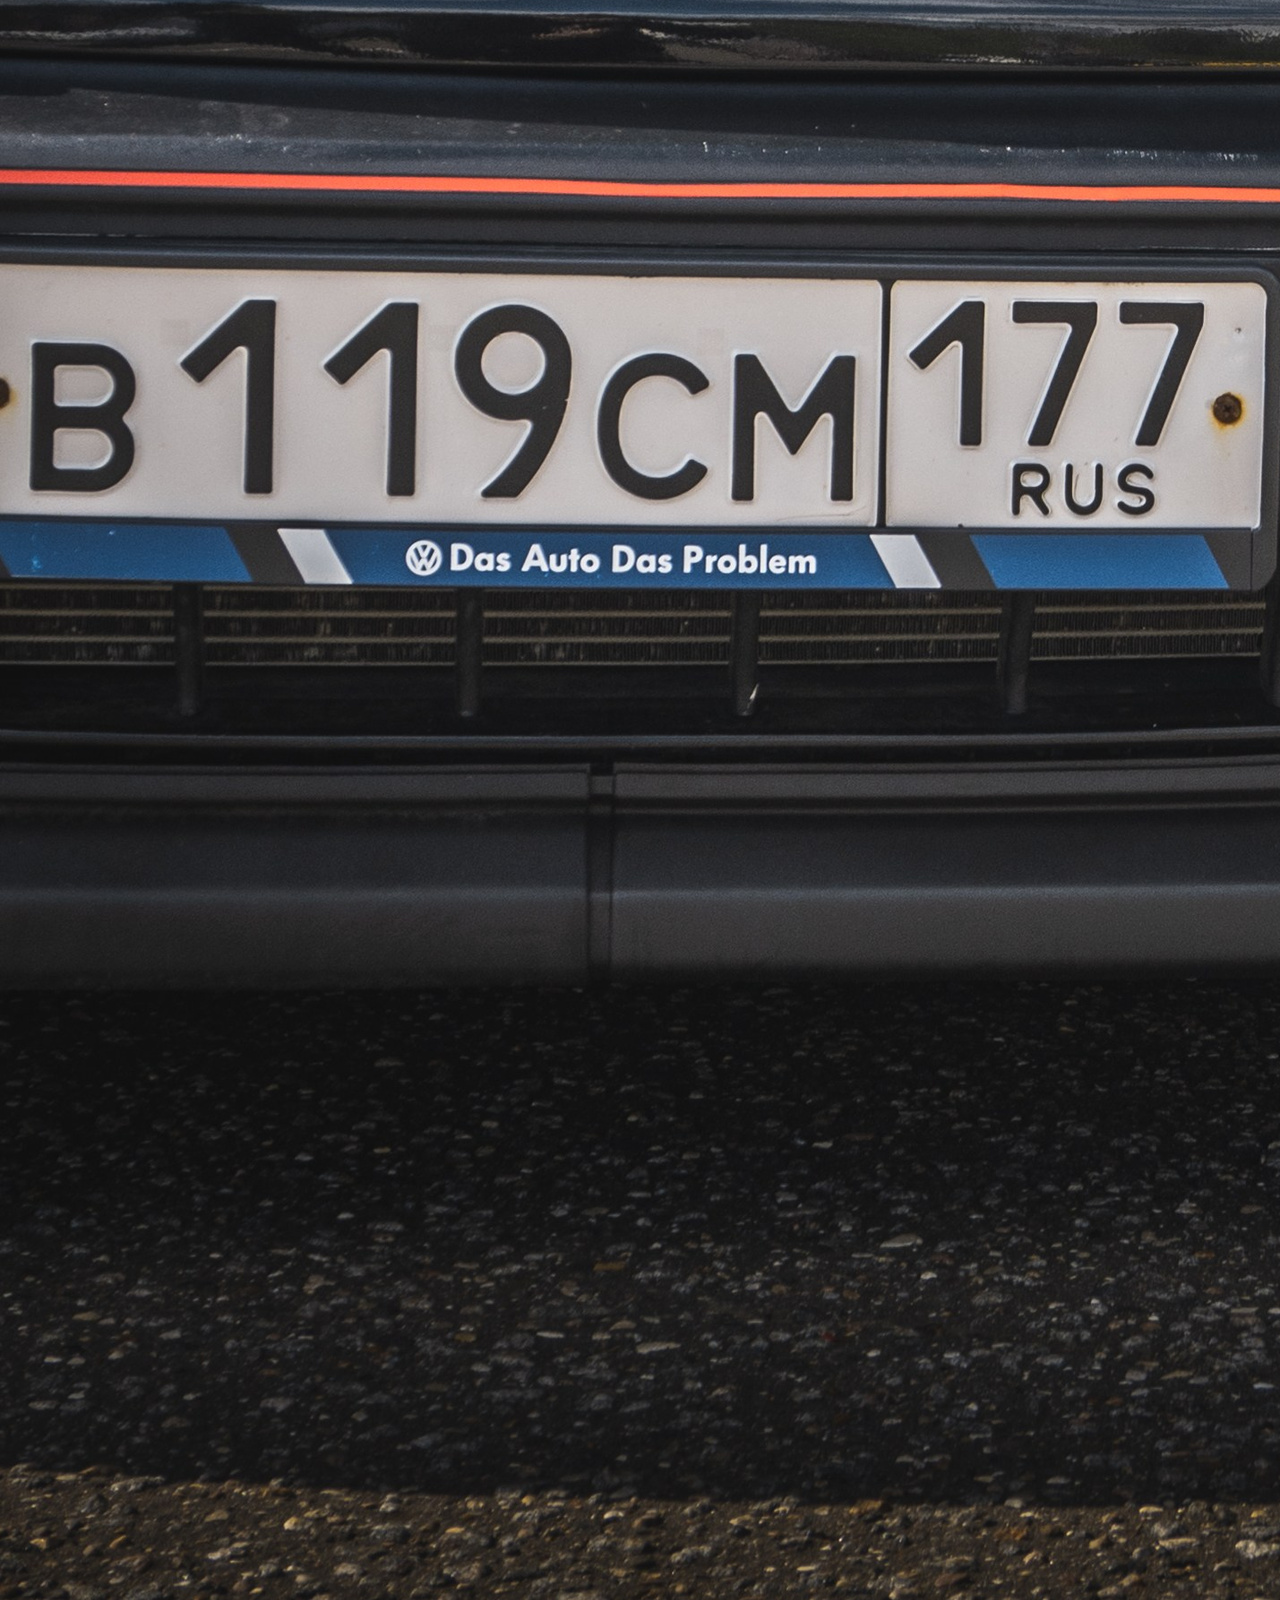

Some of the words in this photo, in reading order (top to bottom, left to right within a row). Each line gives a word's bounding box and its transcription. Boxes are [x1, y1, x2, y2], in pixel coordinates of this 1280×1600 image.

[907, 300, 1205, 448] 177
[1012, 462, 1155, 516] RUS
[450, 543, 511, 572] Das
[521, 544, 600, 573] Auto
[612, 544, 673, 574] Das
[683, 543, 817, 575] Problem
